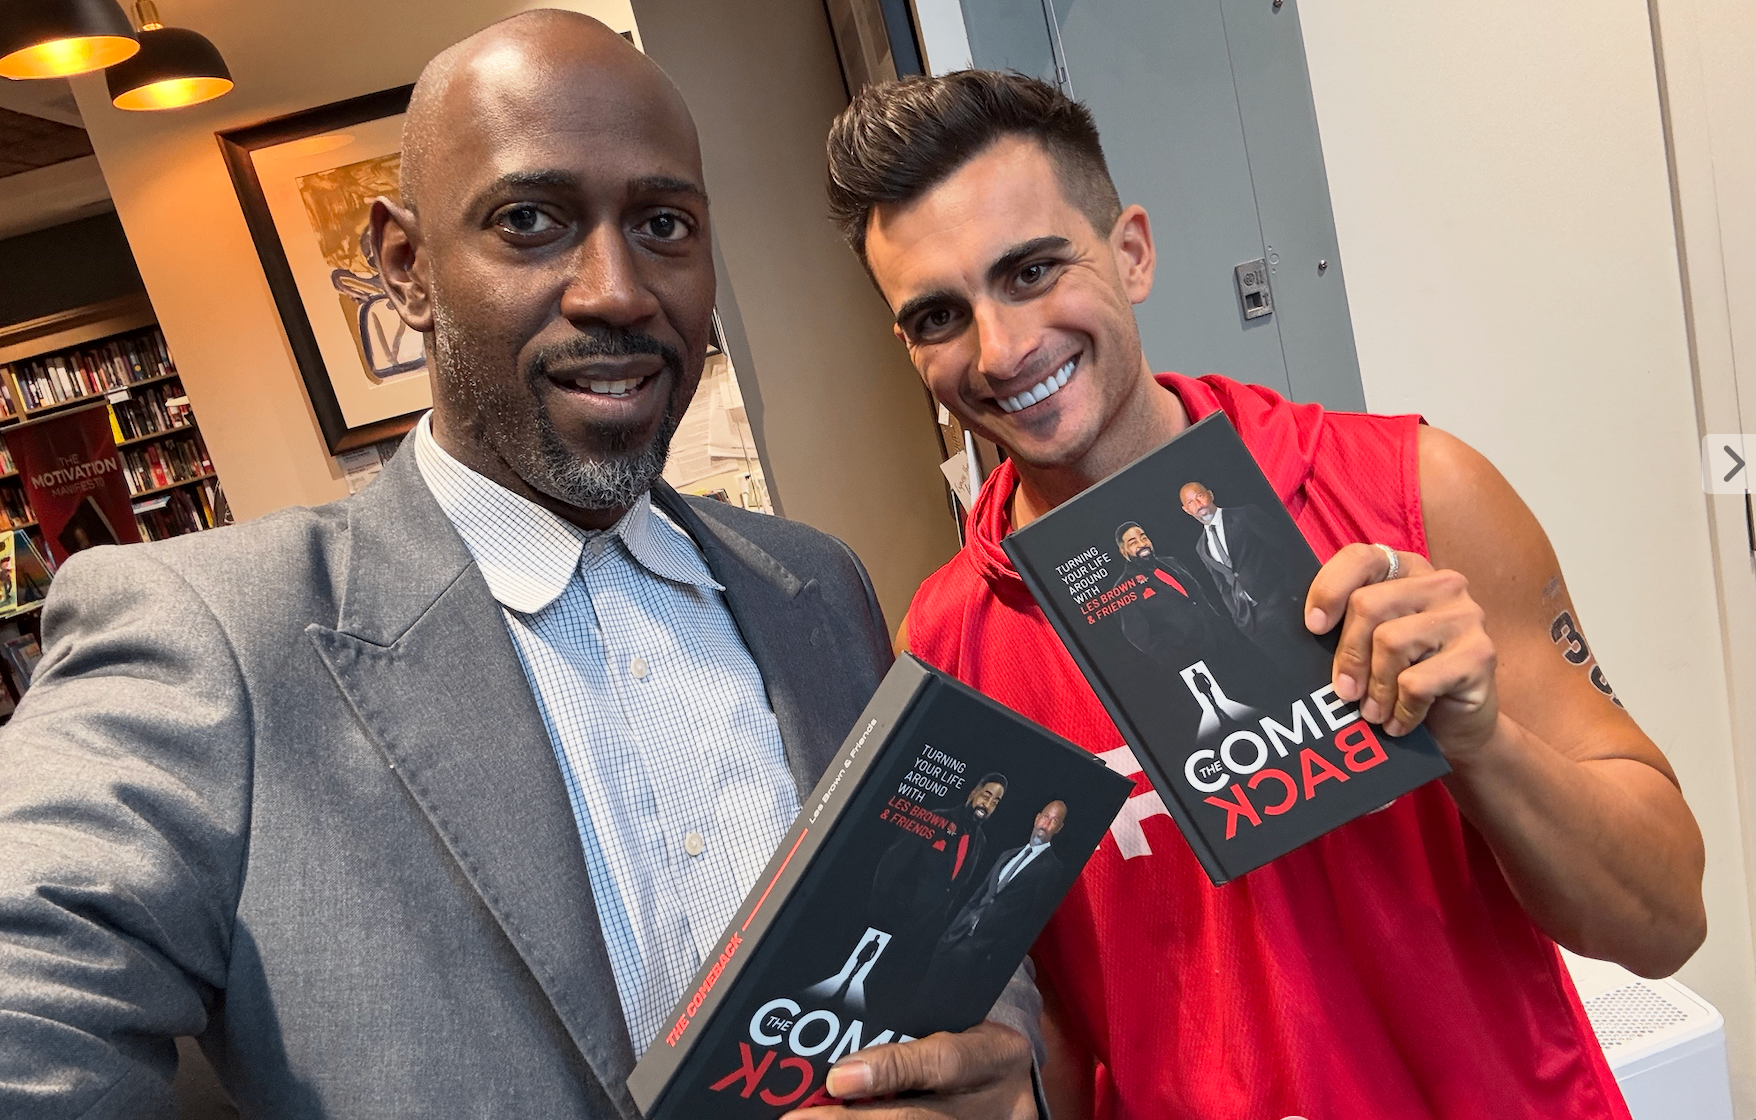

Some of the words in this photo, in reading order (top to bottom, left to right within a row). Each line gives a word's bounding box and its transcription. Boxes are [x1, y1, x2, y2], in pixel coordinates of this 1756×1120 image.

[30, 457, 118, 490] MOTIVATION
[59, 453, 80, 467] THE
[51, 476, 106, 498] MANIFESTO
[1055, 546, 1099, 575] TURNING
[1061, 565, 1089, 585] YOUR
[1088, 552, 1111, 571] LIFE
[1069, 568, 1109, 596] AROUND
[1073, 586, 1101, 605] WITH
[1080, 599, 1101, 615] LES
[1100, 578, 1137, 604] BROWN
[1086, 615, 1096, 625] &
[1095, 592, 1138, 620] FRIENDS
[1184, 682, 1362, 793] COME
[808, 803, 824, 824] Les
[822, 769, 846, 803] Brown
[849, 718, 878, 758] Friends
[913, 757, 942, 779] YOUR
[940, 770, 966, 790] LIFE
[921, 743, 967, 774] TURNING
[1199, 760, 1223, 779] THE
[897, 782, 926, 803] WITH
[904, 770, 949, 797] AROUND
[879, 808, 891, 820] &
[890, 812, 936, 840] FRIENDS
[887, 795, 911, 812] LES
[909, 805, 949, 830] BROWN
[665, 1013, 690, 1047] THE
[686, 931, 743, 1018] COMEBACK
[750, 998, 918, 1064] COM
[766, 1015, 793, 1032] THE
